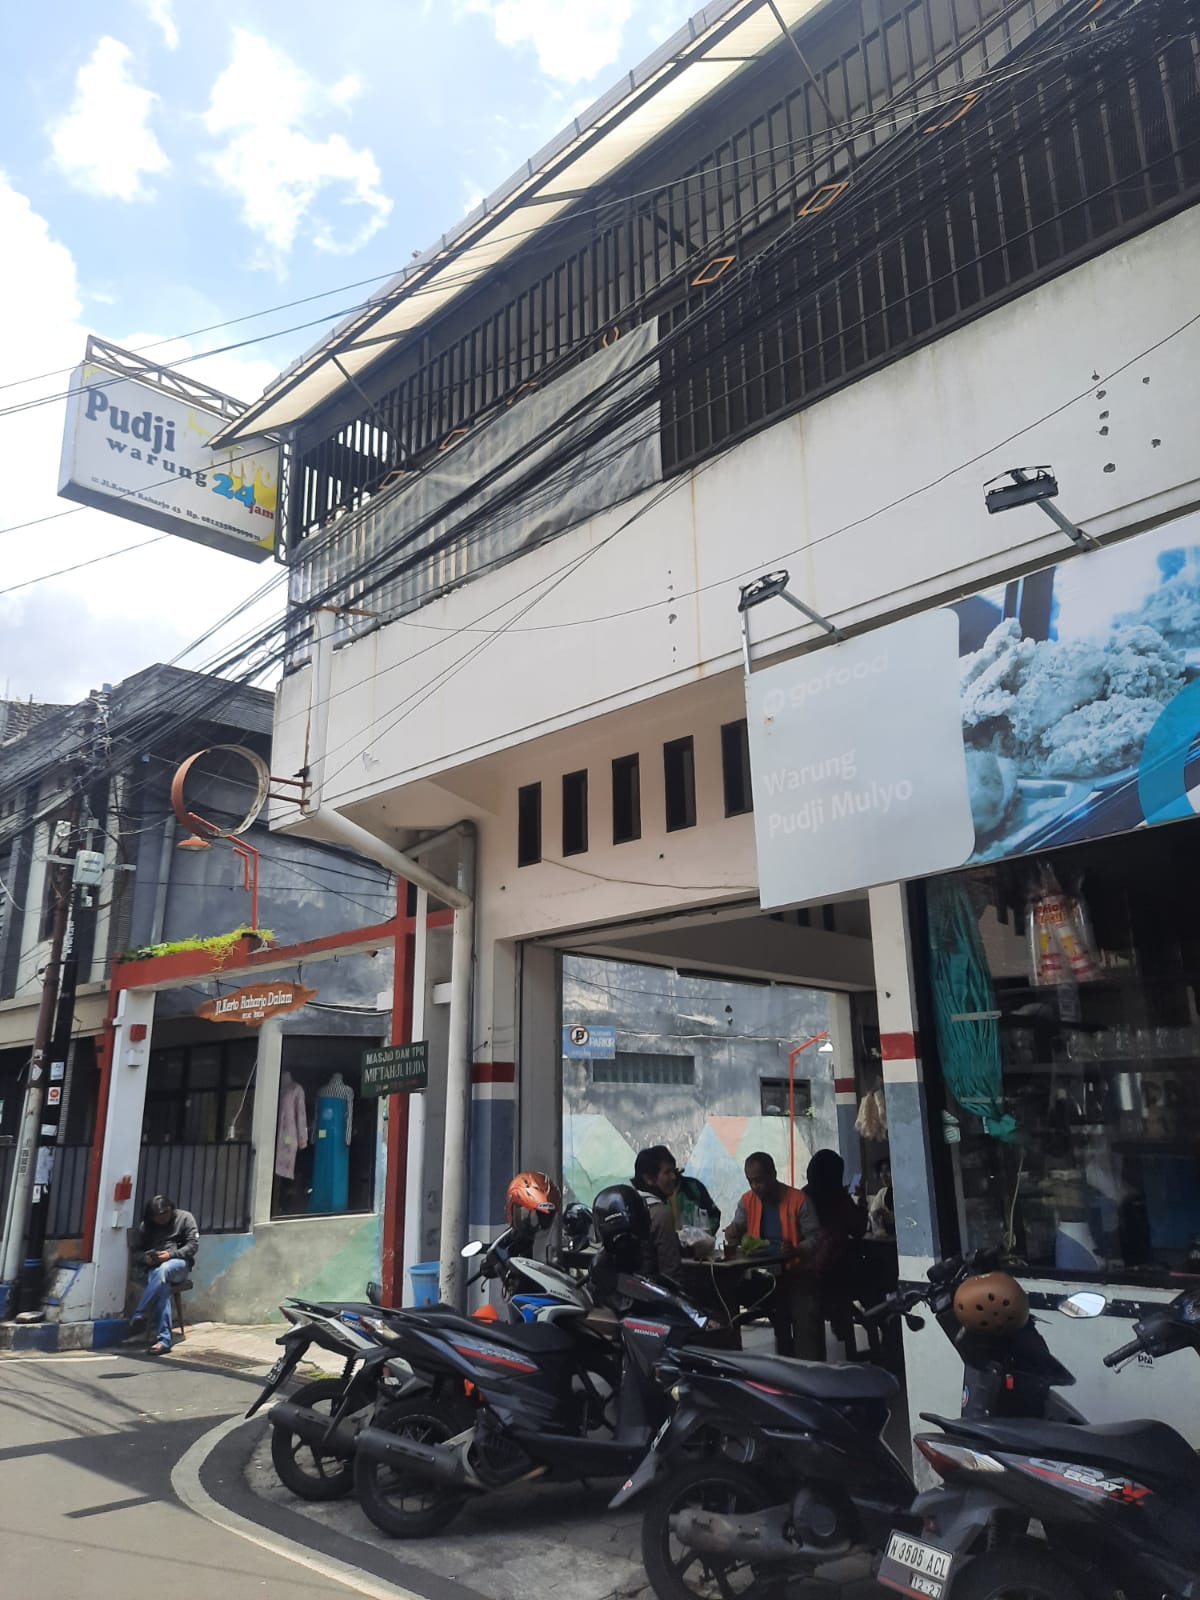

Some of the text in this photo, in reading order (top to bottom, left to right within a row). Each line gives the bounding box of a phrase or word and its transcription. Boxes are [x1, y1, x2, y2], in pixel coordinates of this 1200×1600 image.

[85, 387, 176, 454] Pudji
[106, 437, 208, 488] warung
[212, 473, 256, 508] 24
[247, 502, 274, 520] jam
[762, 749, 857, 796] Warung
[768, 779, 913, 838] Pudji Mulyo
[267, 990, 293, 1006] Dalam
[366, 1050, 394, 1065] MASJID
[395, 1047, 410, 1060] DAN
[634, 1328, 660, 1338] HONDA
[889, 1536, 947, 1579] N 3505 ACL
